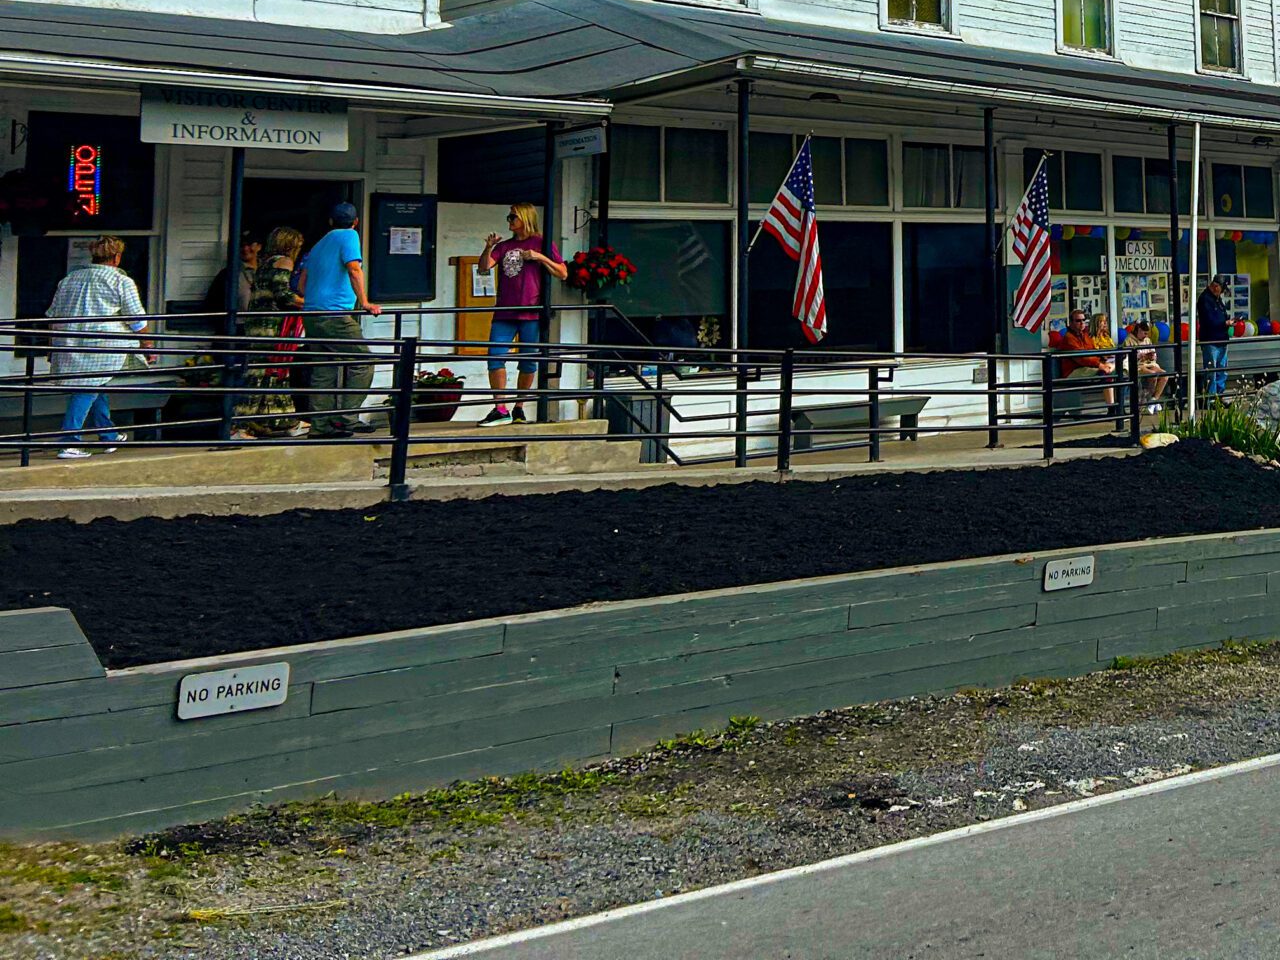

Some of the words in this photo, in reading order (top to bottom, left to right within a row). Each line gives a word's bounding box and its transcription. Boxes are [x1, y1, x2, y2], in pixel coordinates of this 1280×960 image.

[160, 89, 247, 109] VISITOR
[252, 94, 332, 114] CENTER
[241, 111, 257, 126] &
[171, 123, 321, 145] INFORMATION
[1127, 242, 1153, 255] CASS
[1103, 256, 1173, 271] HMECOMIN
[1049, 570, 1059, 580] NO
[1061, 565, 1091, 579] PARKING
[186, 688, 209, 704] NO
[216, 678, 281, 700] PARKING
